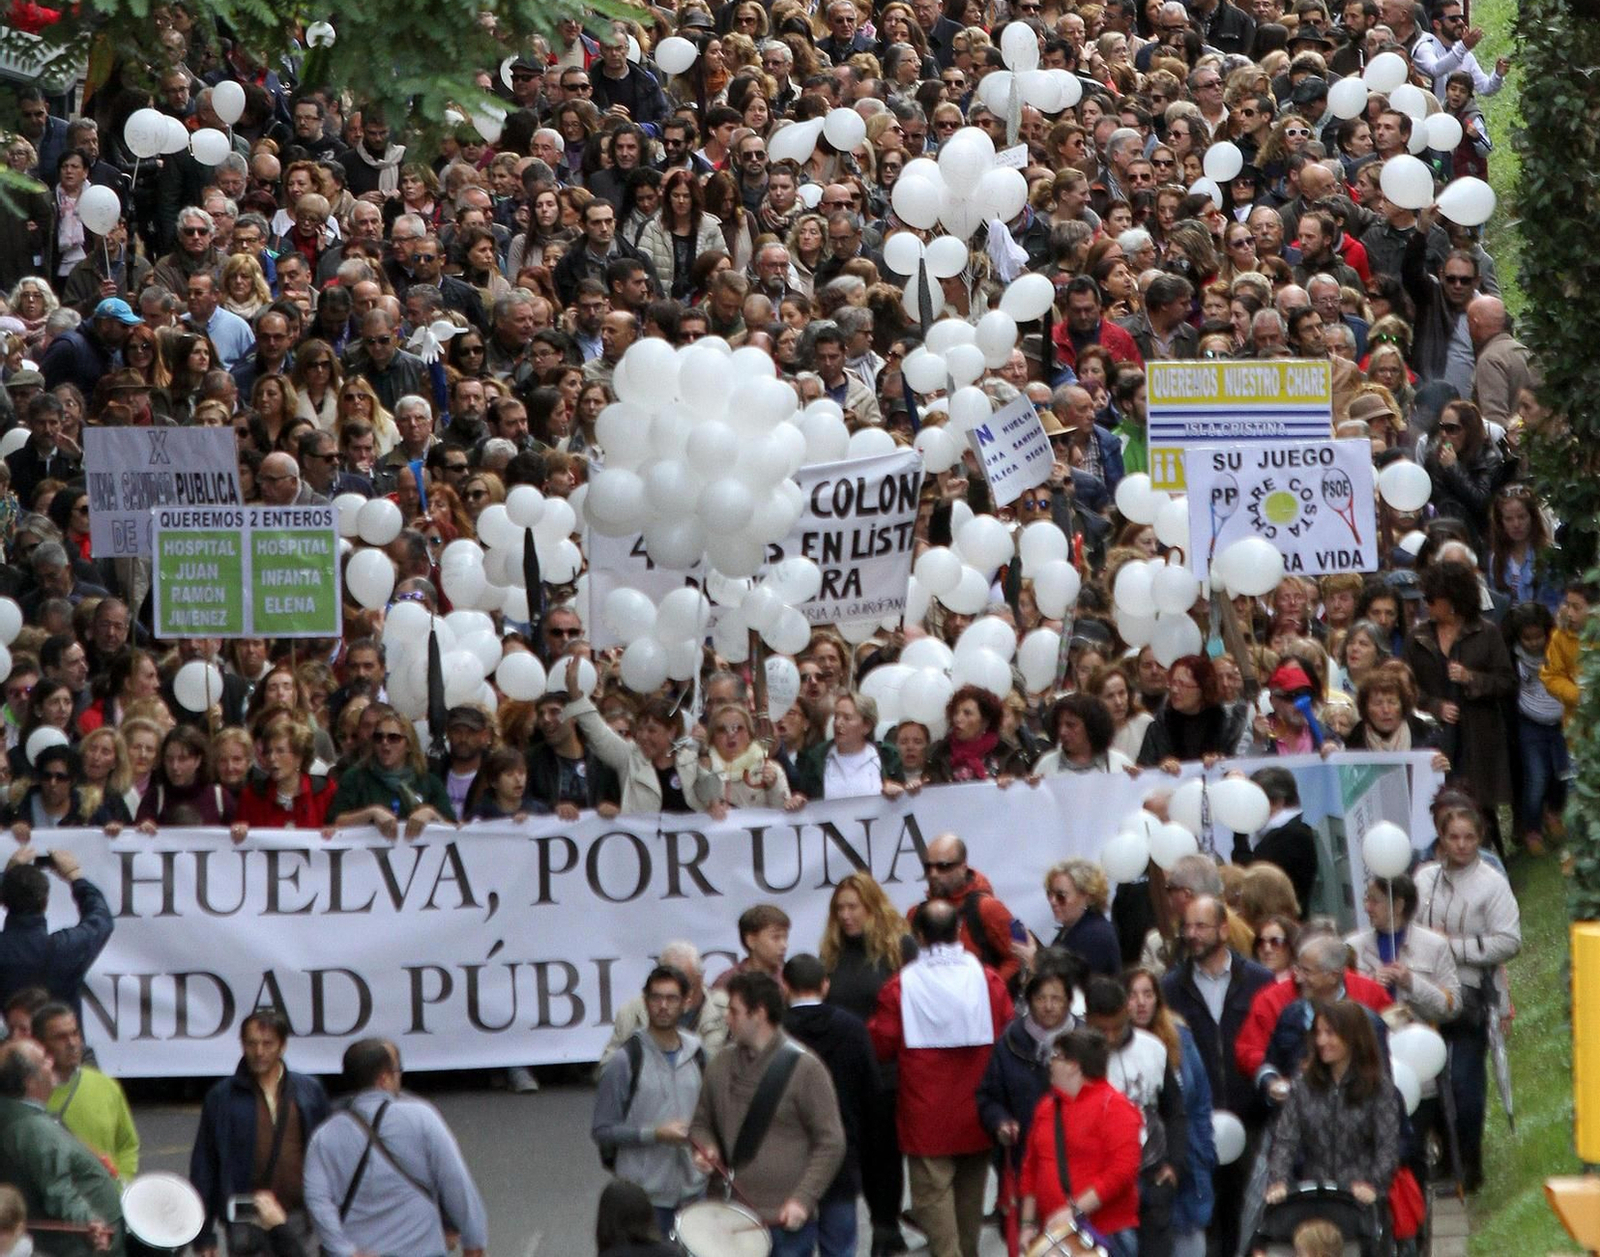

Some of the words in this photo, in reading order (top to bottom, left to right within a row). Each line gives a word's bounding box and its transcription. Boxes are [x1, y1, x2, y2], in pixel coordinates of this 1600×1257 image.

[1225, 367, 1280, 397] NUESTRO
[1221, 422, 1289, 437] CRISTINA
[147, 430, 171, 465] X
[1213, 452, 1242, 472] SU
[1258, 447, 1335, 470] JUEGO
[810, 471, 920, 519] COLON
[1211, 487, 1238, 506] PP
[1322, 479, 1350, 500] PSOE
[1288, 478, 1317, 538] COSTA
[160, 511, 244, 528] QUEREMOS
[250, 511, 258, 528] 2
[263, 509, 333, 527] ENTEROS
[163, 539, 236, 557] HOSPITAL
[257, 538, 329, 555] HOSPITAL
[1316, 549, 1365, 570] VIDA
[175, 563, 219, 581] JUAN
[261, 568, 322, 586] INFANTA
[265, 596, 316, 613] ELENA
[112, 842, 499, 922] HUELVA,
[531, 830, 724, 906] POR
[743, 812, 928, 896] UNA
